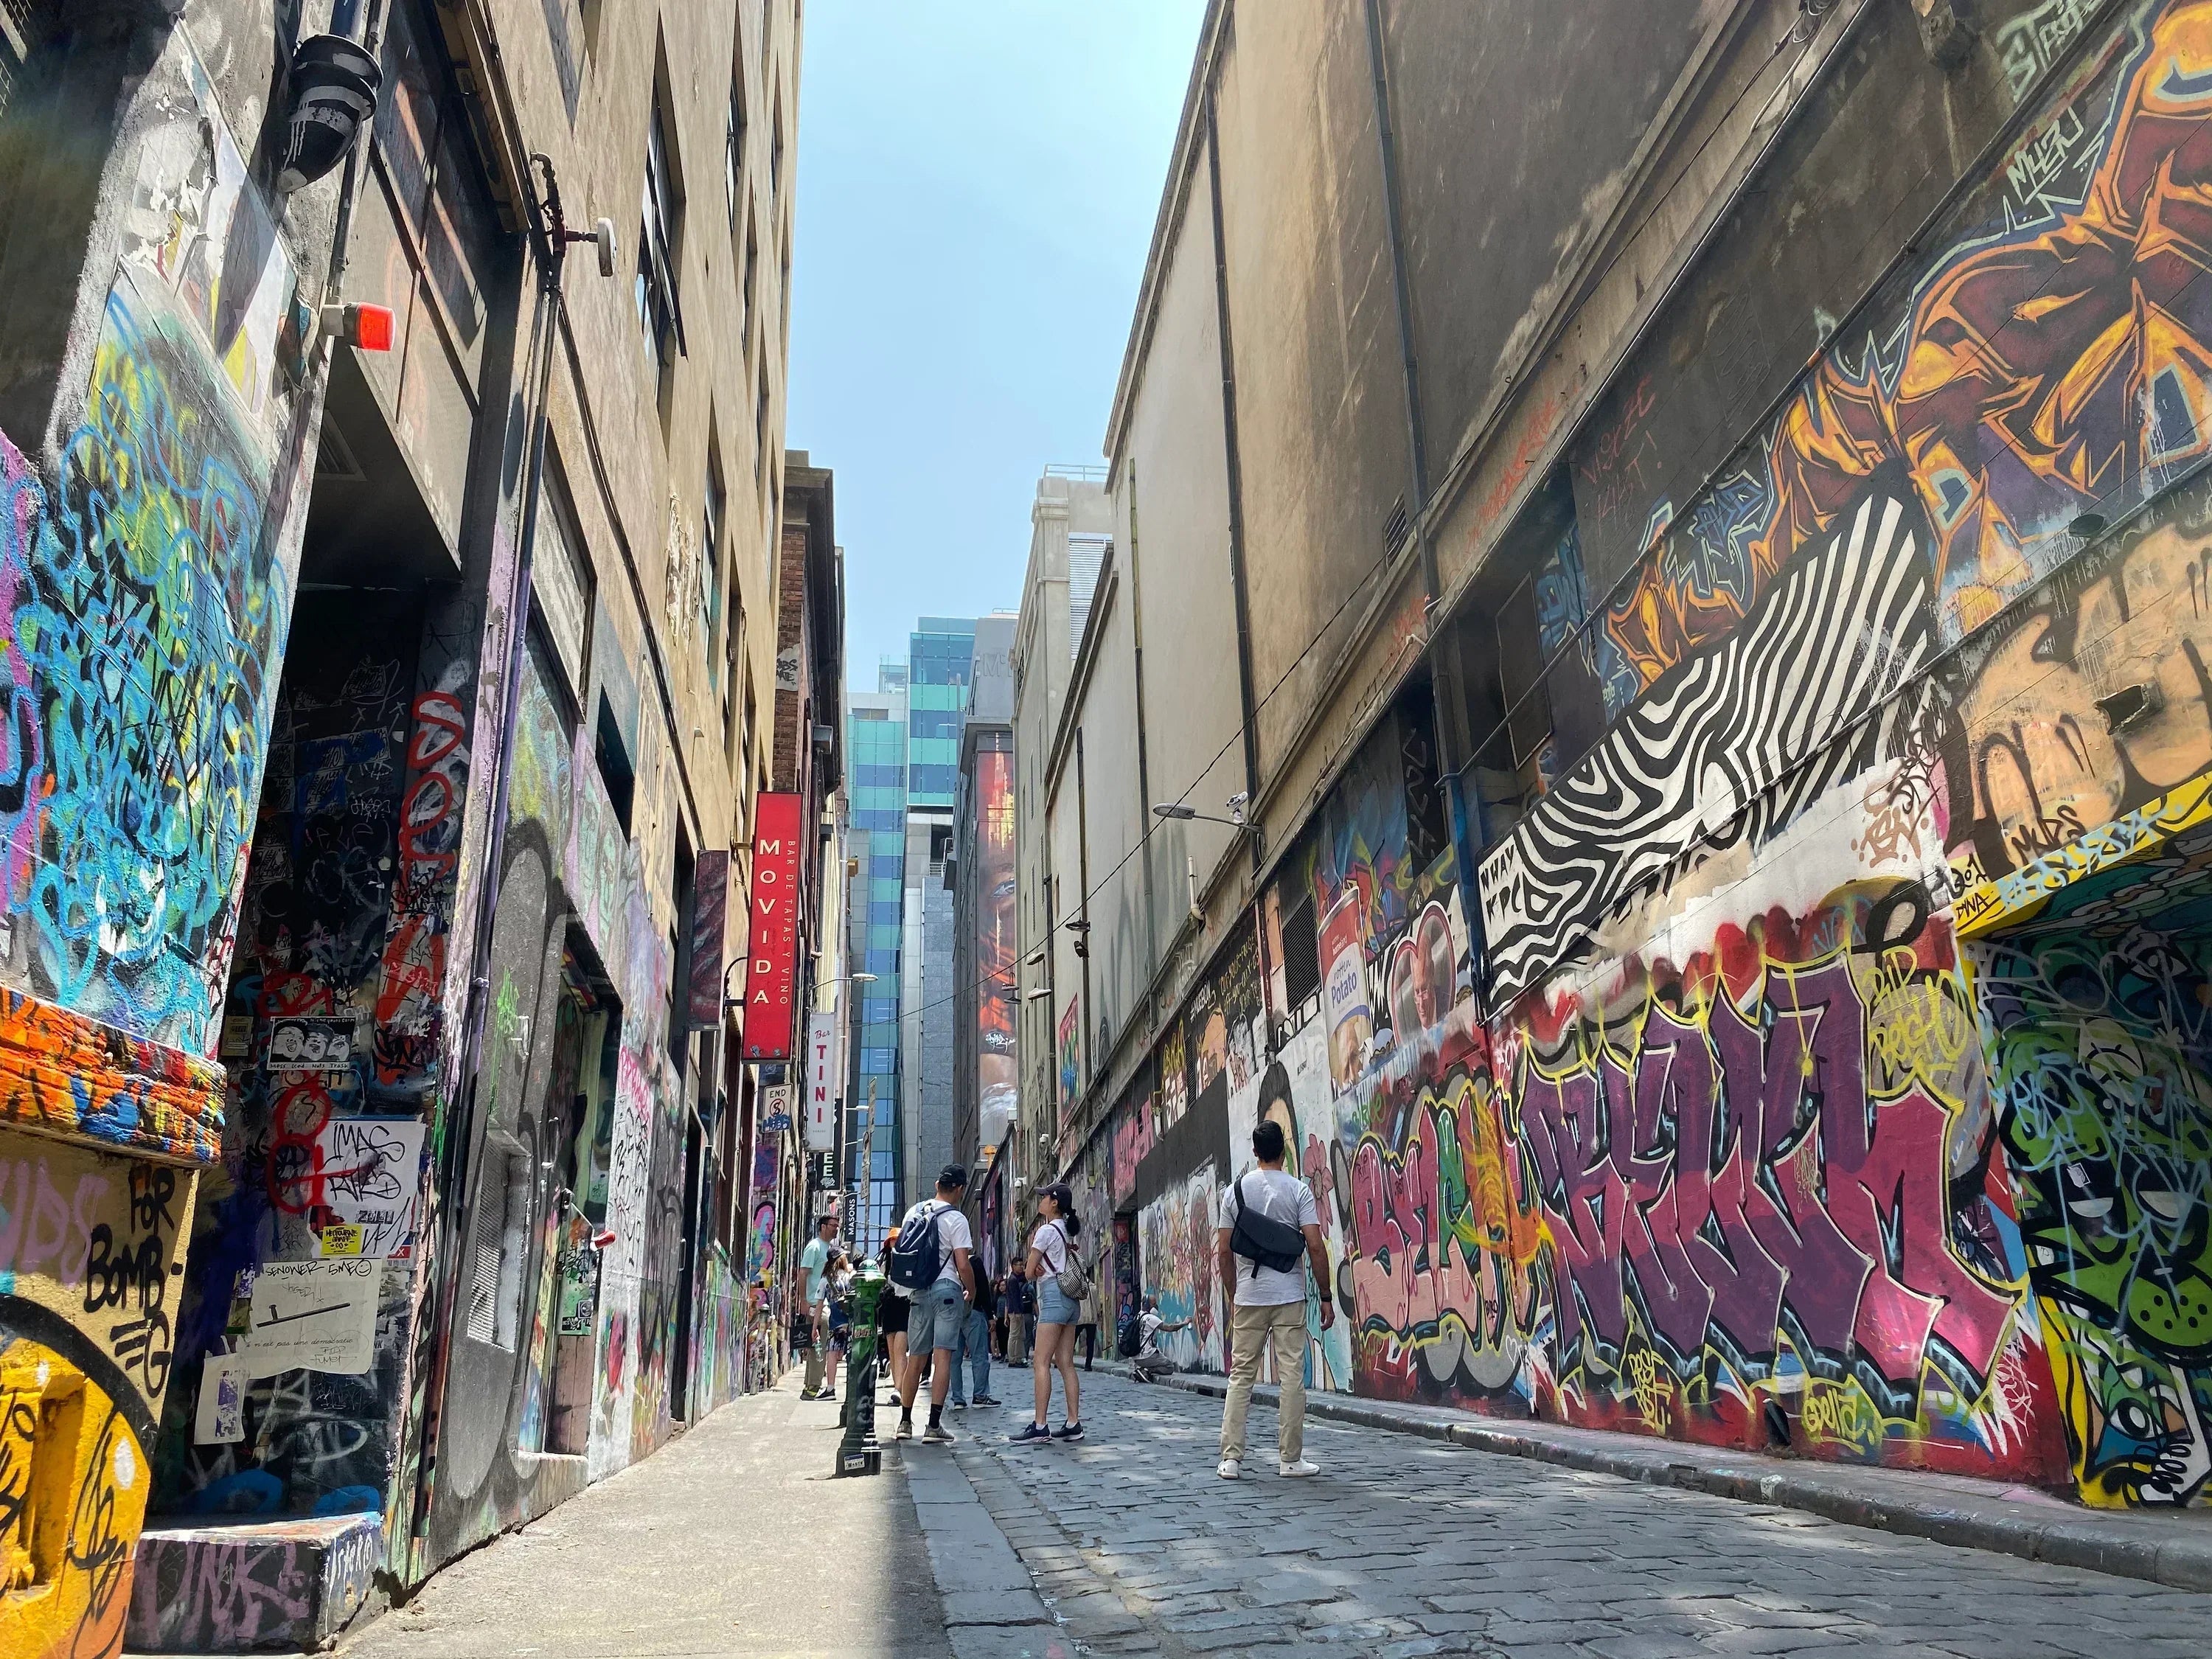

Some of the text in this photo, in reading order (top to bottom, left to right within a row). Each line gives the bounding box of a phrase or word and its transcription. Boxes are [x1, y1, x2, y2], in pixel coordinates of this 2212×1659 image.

[787, 841, 796, 865] BAR
[785, 874, 794, 890] DE
[753, 839, 780, 1004] MOVIDA
[783, 899, 793, 942] TAPAS
[779, 967, 790, 1004] VINO
[1332, 972, 1357, 1009] Potato
[815, 1029, 831, 1039] Bar
[769, 1089, 786, 1098] END
[815, 1045, 827, 1122] TINI
[848, 1198, 856, 1236] MASONS
